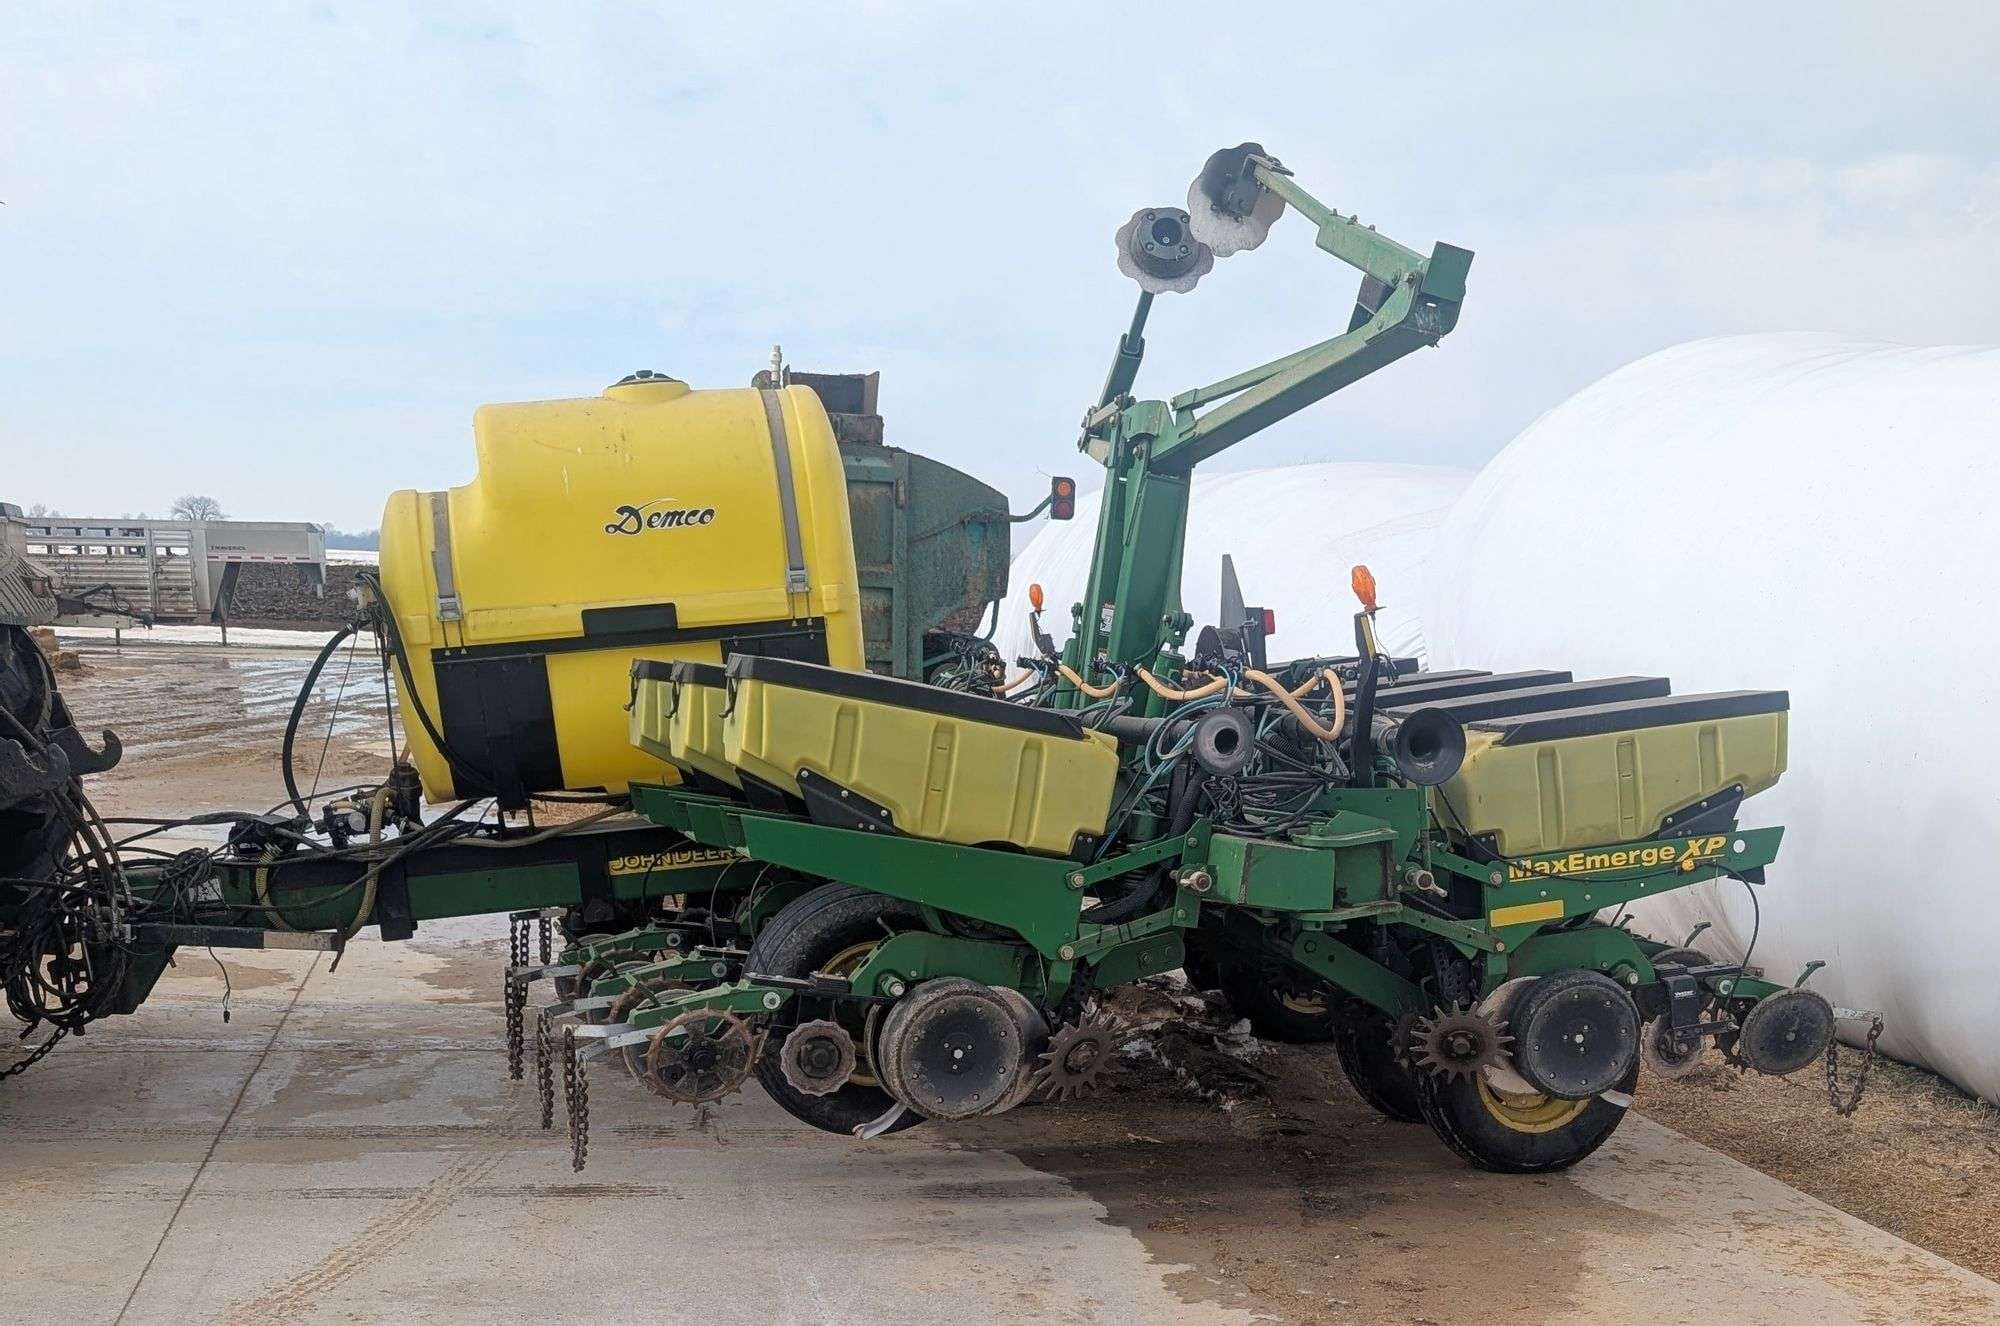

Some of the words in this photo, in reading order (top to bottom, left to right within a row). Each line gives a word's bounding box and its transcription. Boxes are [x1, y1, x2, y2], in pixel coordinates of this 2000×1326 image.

[604, 498, 715, 535] Demco
[610, 852, 671, 871] JOHN
[674, 849, 738, 864] DEER
[1508, 845, 1677, 879] MaxEmerge
[1677, 835, 1727, 862] XP
